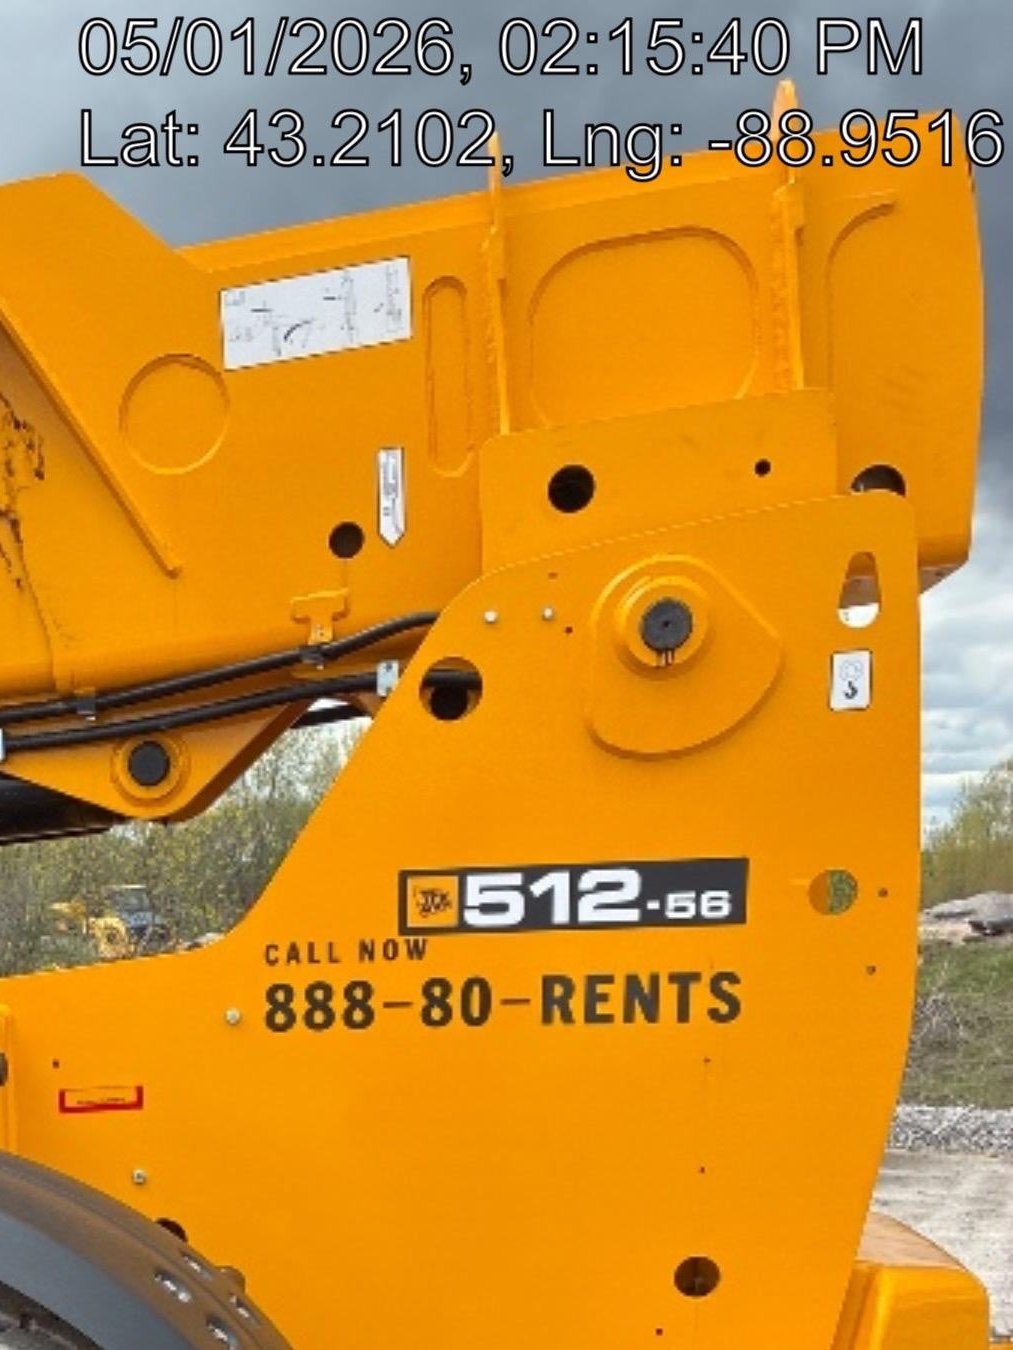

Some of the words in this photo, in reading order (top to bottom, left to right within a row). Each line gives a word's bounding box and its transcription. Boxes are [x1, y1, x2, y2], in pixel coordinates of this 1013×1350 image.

[463, 868, 733, 928] 512-56
[264, 942, 341, 967] CALL
[358, 938, 428, 962] NOW
[264, 971, 743, 1033] 888-80-RENTS
